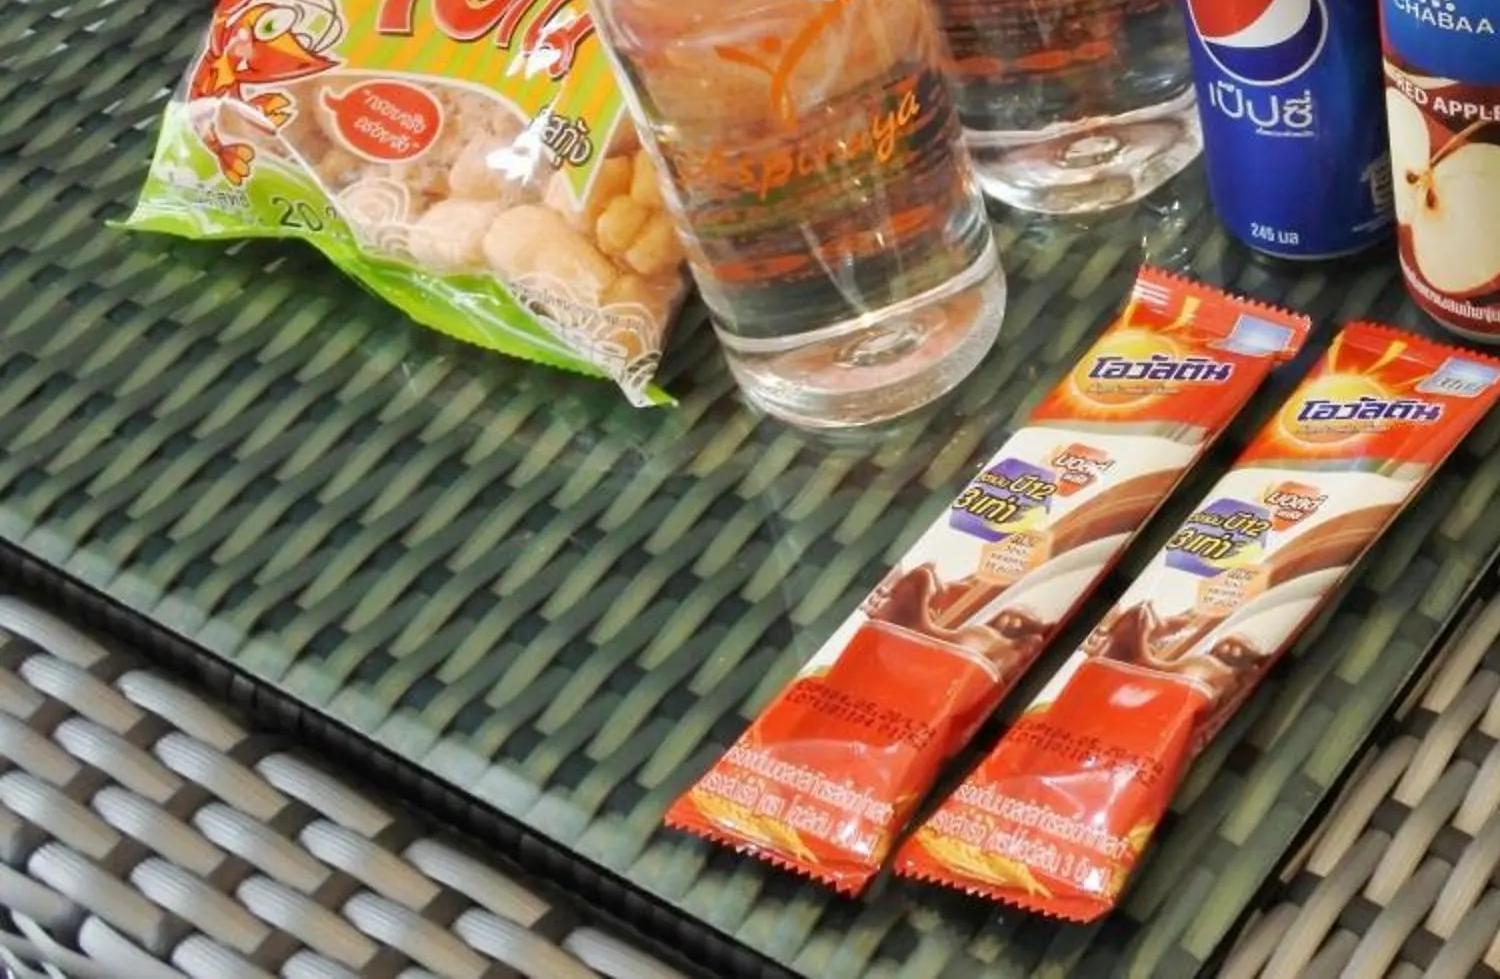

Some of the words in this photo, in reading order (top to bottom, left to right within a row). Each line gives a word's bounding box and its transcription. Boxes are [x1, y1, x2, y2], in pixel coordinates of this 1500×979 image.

[1251, 222, 1275, 243] 245
[1088, 354, 1232, 381] โอวัลติน
[1297, 396, 1443, 422] โอวัลติน
